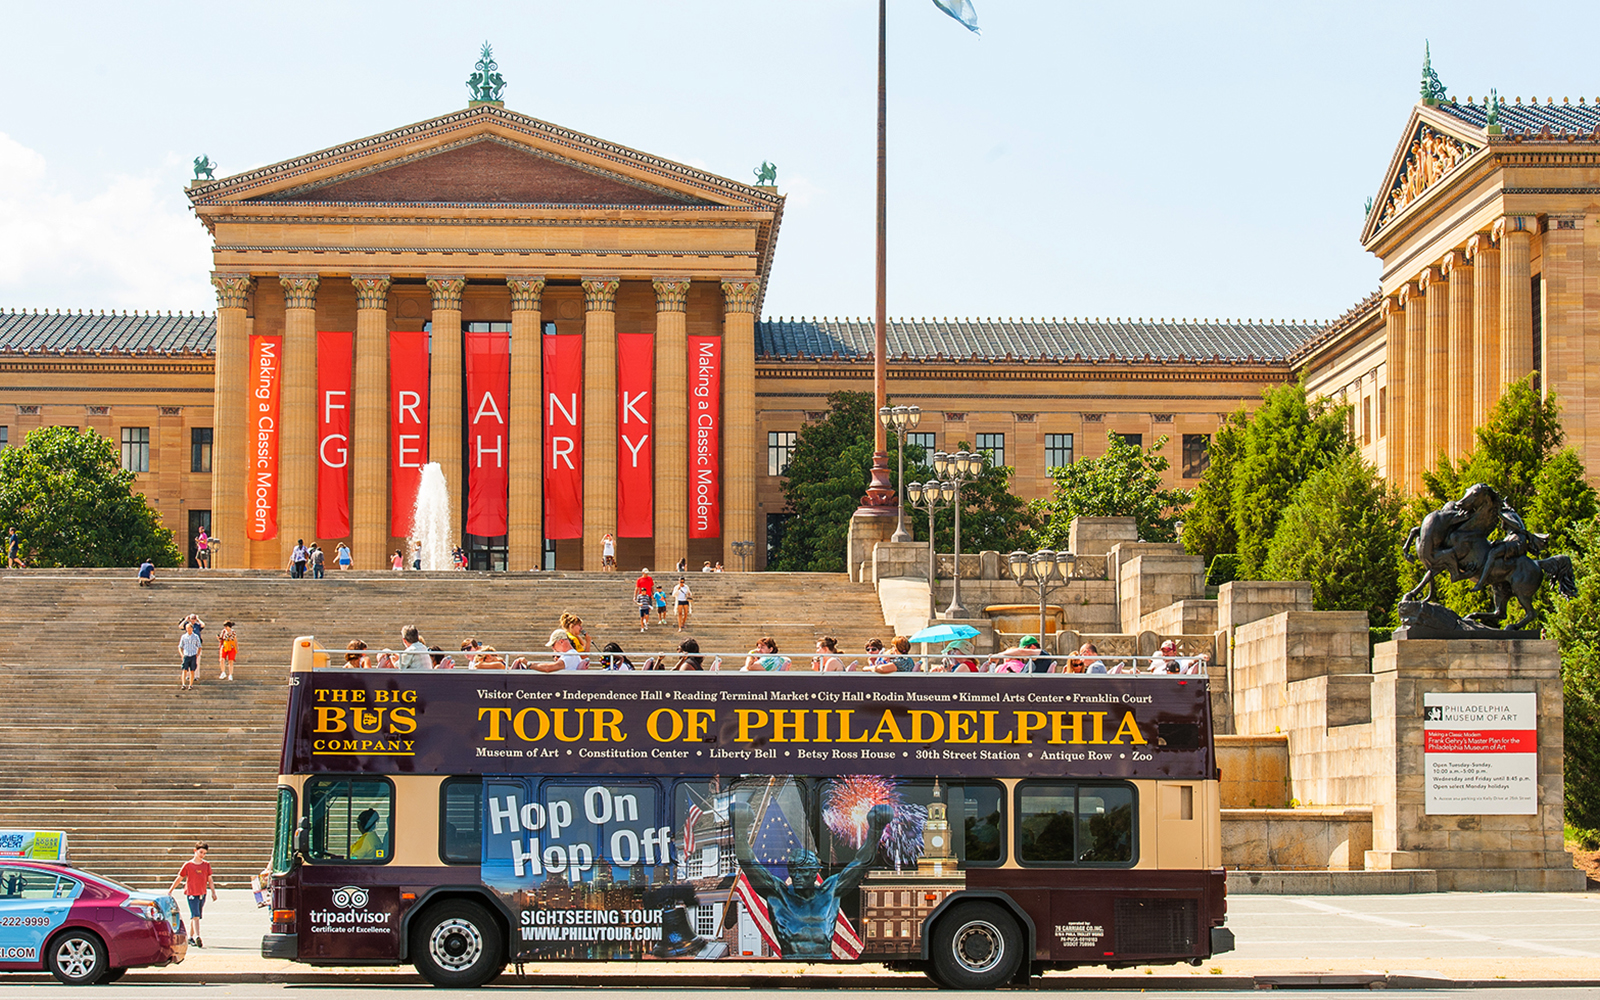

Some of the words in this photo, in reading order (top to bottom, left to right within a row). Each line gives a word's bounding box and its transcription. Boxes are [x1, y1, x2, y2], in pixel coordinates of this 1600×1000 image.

[255, 343, 275, 399] Making
[694, 343, 714, 396] Making
[259, 403, 270, 412] a
[698, 401, 709, 409] a
[257, 416, 274, 468] Classic
[697, 414, 713, 465] Classic
[255, 473, 272, 533] Modern
[697, 469, 713, 531] Modern
[314, 689, 366, 703] THE
[375, 689, 418, 703] BIG
[477, 689, 514, 701] Visitor
[516, 690, 553, 701] Center
[563, 690, 638, 703] Independence
[641, 691, 663, 701] Hall
[674, 691, 718, 704] Reading
[720, 691, 768, 702] Terminal
[771, 691, 809, 702] Market
[818, 692, 840, 705] City
[842, 692, 864, 702] Hall
[873, 692, 905, 702] Rodin
[907, 692, 951, 702] Museum
[960, 693, 1000, 703] Kimmel
[1003, 693, 1026, 703] Arts
[1028, 693, 1064, 703] Center
[1074, 694, 1120, 704] Franklin
[1122, 694, 1152, 704] Court
[1445, 705, 1510, 713] PHILADELPHIA
[313, 706, 418, 734] BUS
[478, 707, 627, 743] TOUR
[646, 708, 716, 743] OF
[734, 708, 1148, 745] PHILADELPHIA
[313, 739, 415, 751] COMPANY
[1444, 737, 1467, 745] Gehry's
[476, 747, 523, 758] Museum
[526, 747, 538, 758] of
[540, 748, 559, 758] Art
[579, 748, 648, 758] Constitution
[652, 749, 689, 759] Center
[710, 748, 752, 761] Liberty
[755, 749, 777, 759] Bell
[798, 749, 829, 762] Betsy
[833, 750, 858, 759] Ross
[861, 750, 896, 759] House
[916, 750, 940, 759] 30th
[943, 750, 977, 760] Street
[980, 750, 1021, 760] Station
[1041, 751, 1085, 763] Antique
[1088, 751, 1113, 761] Row
[1133, 752, 1153, 761] Zoo
[489, 795, 573, 839] Hop
[583, 786, 639, 825] On
[511, 837, 593, 882] Hop
[610, 826, 671, 867] Off
[309, 908, 391, 926] tripadvisor
[520, 910, 619, 925] SIGHTSEEING
[621, 909, 663, 924] TOUR
[311, 925, 346, 933] Certificate
[347, 925, 355, 933] of
[356, 925, 391, 933] Excellence
[521, 926, 663, 941] WWW.PHILLYTOUR.COM
[0, 947, 35, 958] I.COM
